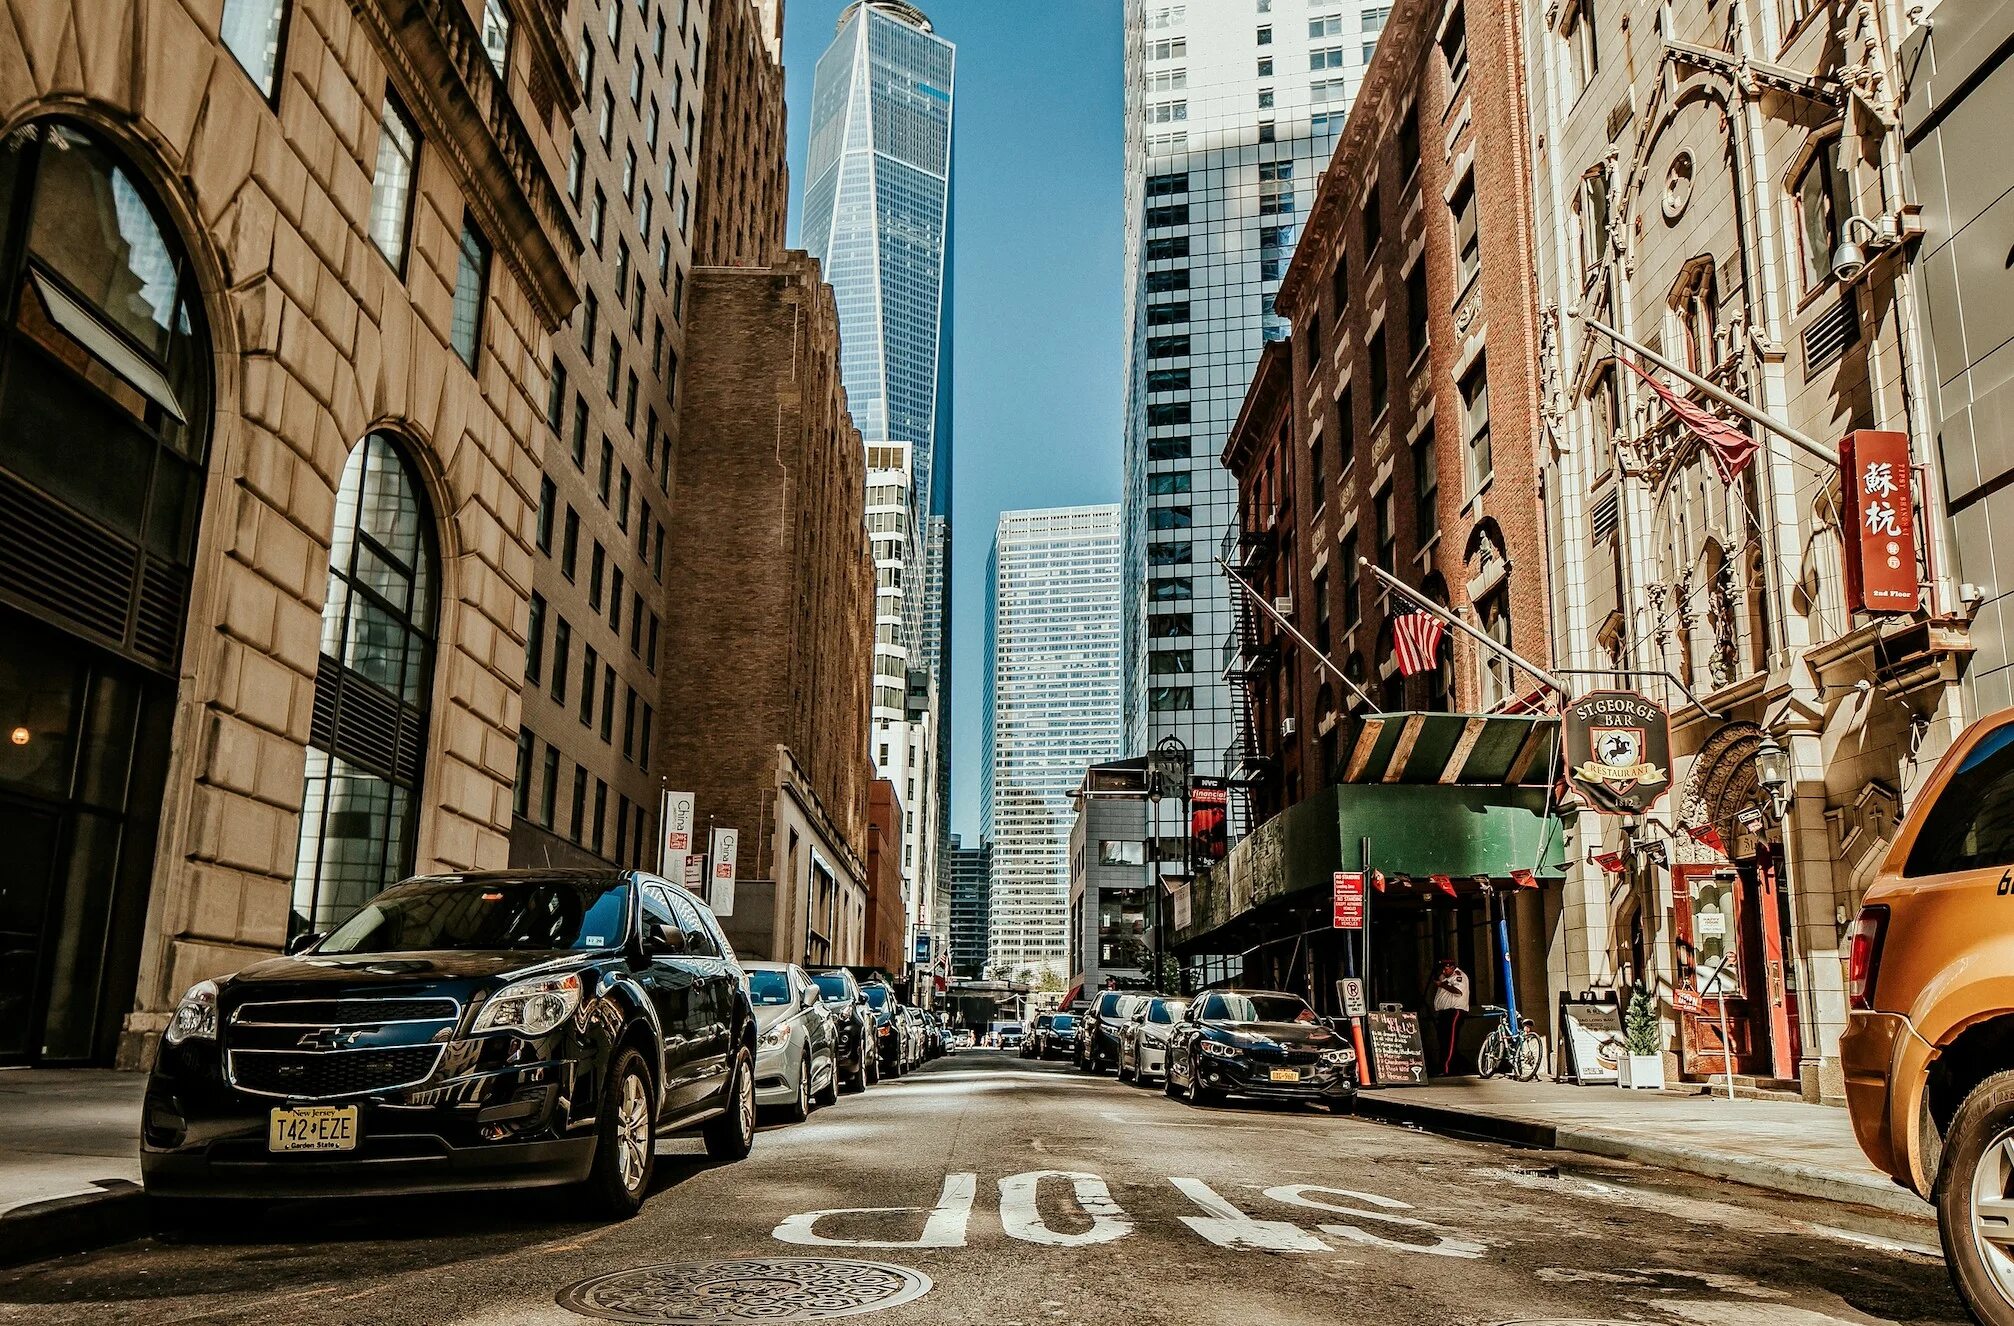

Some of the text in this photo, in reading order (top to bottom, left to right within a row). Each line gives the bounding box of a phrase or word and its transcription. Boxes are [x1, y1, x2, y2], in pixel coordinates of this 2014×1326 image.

[1898, 463, 1906, 489] TIPSY
[1889, 590, 1912, 598] Floor
[1605, 714, 1635, 726] BAR
[1590, 765, 1650, 778] RESTAURANT
[1201, 779, 1218, 787] NYC
[1192, 789, 1227, 798] financial
[676, 800, 690, 831] China
[722, 835, 734, 862] China
[1996, 868, 2014, 896] 6
[292, 1108, 336, 1118] New Jersey
[772, 1171, 1488, 1259] STOP
